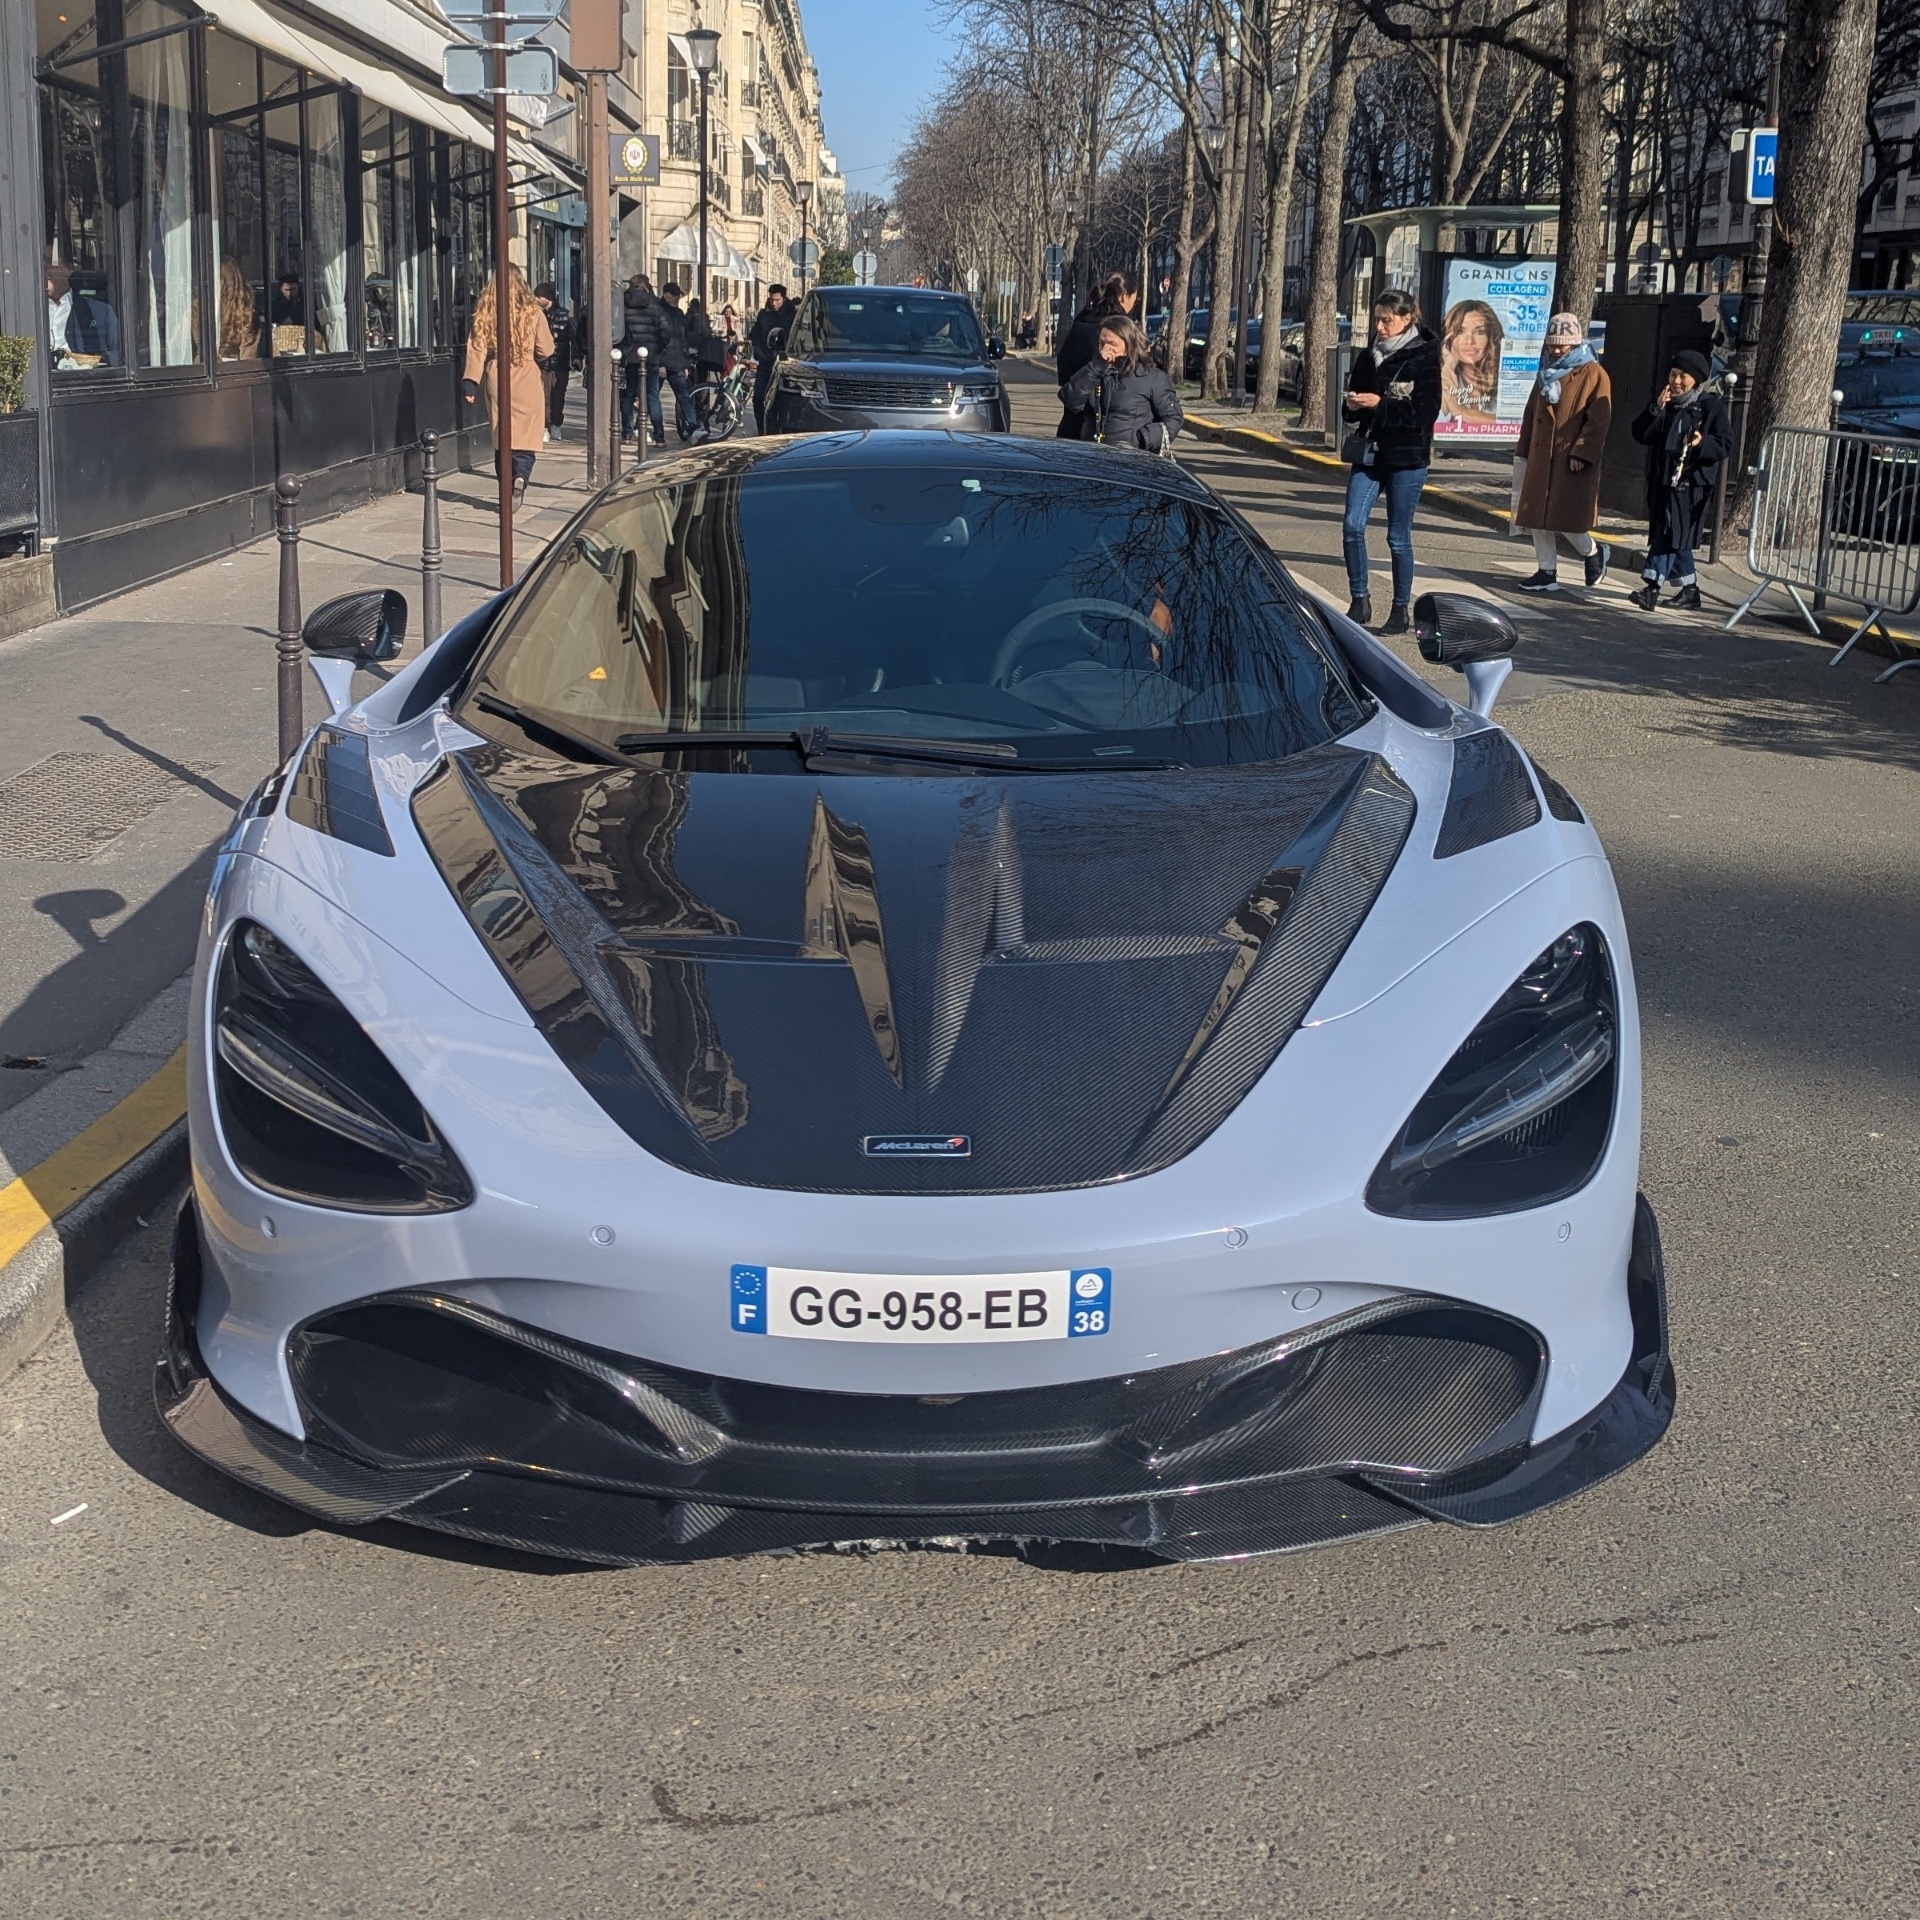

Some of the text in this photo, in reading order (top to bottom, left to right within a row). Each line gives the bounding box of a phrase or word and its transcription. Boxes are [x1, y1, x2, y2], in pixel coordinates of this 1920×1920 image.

[1459, 269, 1549, 281] GRANIONS
[1449, 383, 1474, 398] Ingrid
[1457, 393, 1492, 406] Chauvin
[1467, 425, 1479, 433] EN
[873, 1142, 955, 1150] McLaren
[738, 1303, 758, 1325] F
[789, 1285, 1048, 1331] GG-958-EB
[1073, 1310, 1105, 1333] 38
